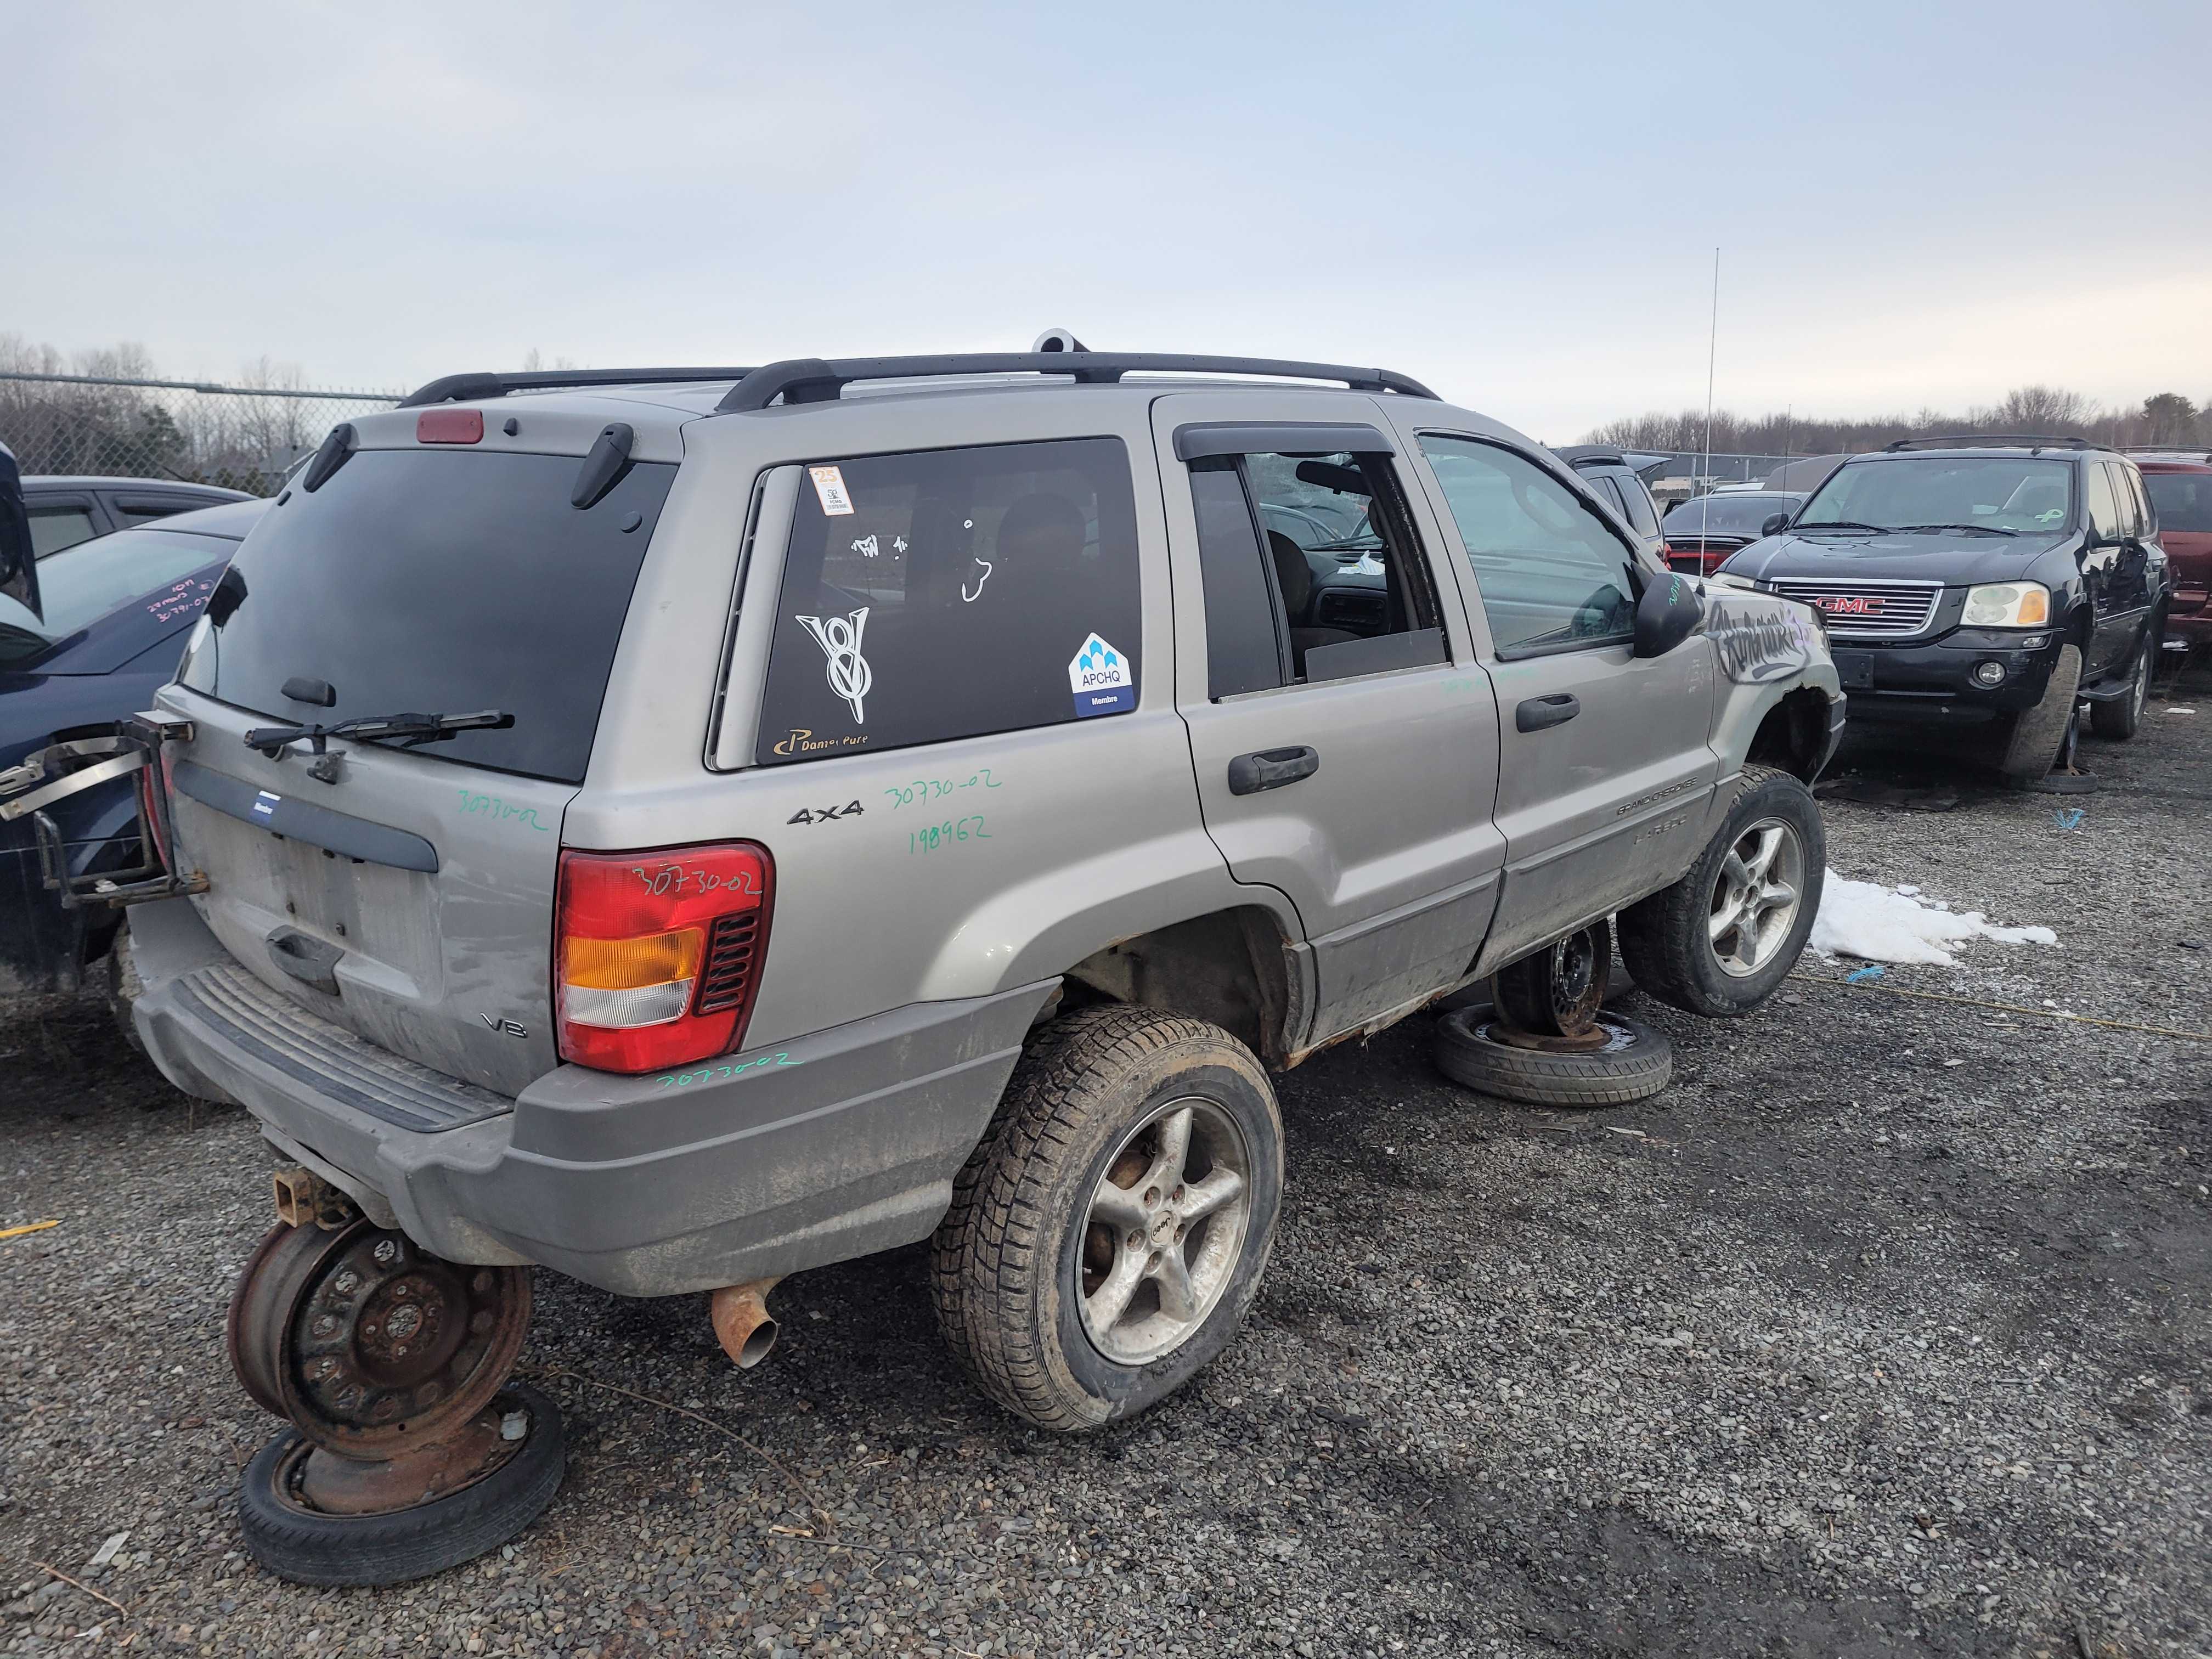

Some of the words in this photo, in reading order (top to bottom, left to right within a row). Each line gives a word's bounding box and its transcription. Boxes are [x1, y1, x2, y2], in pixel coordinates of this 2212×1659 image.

[815, 470, 837, 483] 25
[1815, 597, 1886, 614] GMC
[1082, 670, 1121, 686] APCHQ
[1091, 696, 1118, 706] Membre
[843, 735, 868, 746] Pure
[884, 769, 1003, 810] 30730-02
[1617, 795, 1650, 815] GRAND
[909, 816, 992, 855] 198962
[632, 866, 763, 896] 30730-02
[479, 1012, 528, 1039] V8
[1153, 1217, 1171, 1237] Jeep
